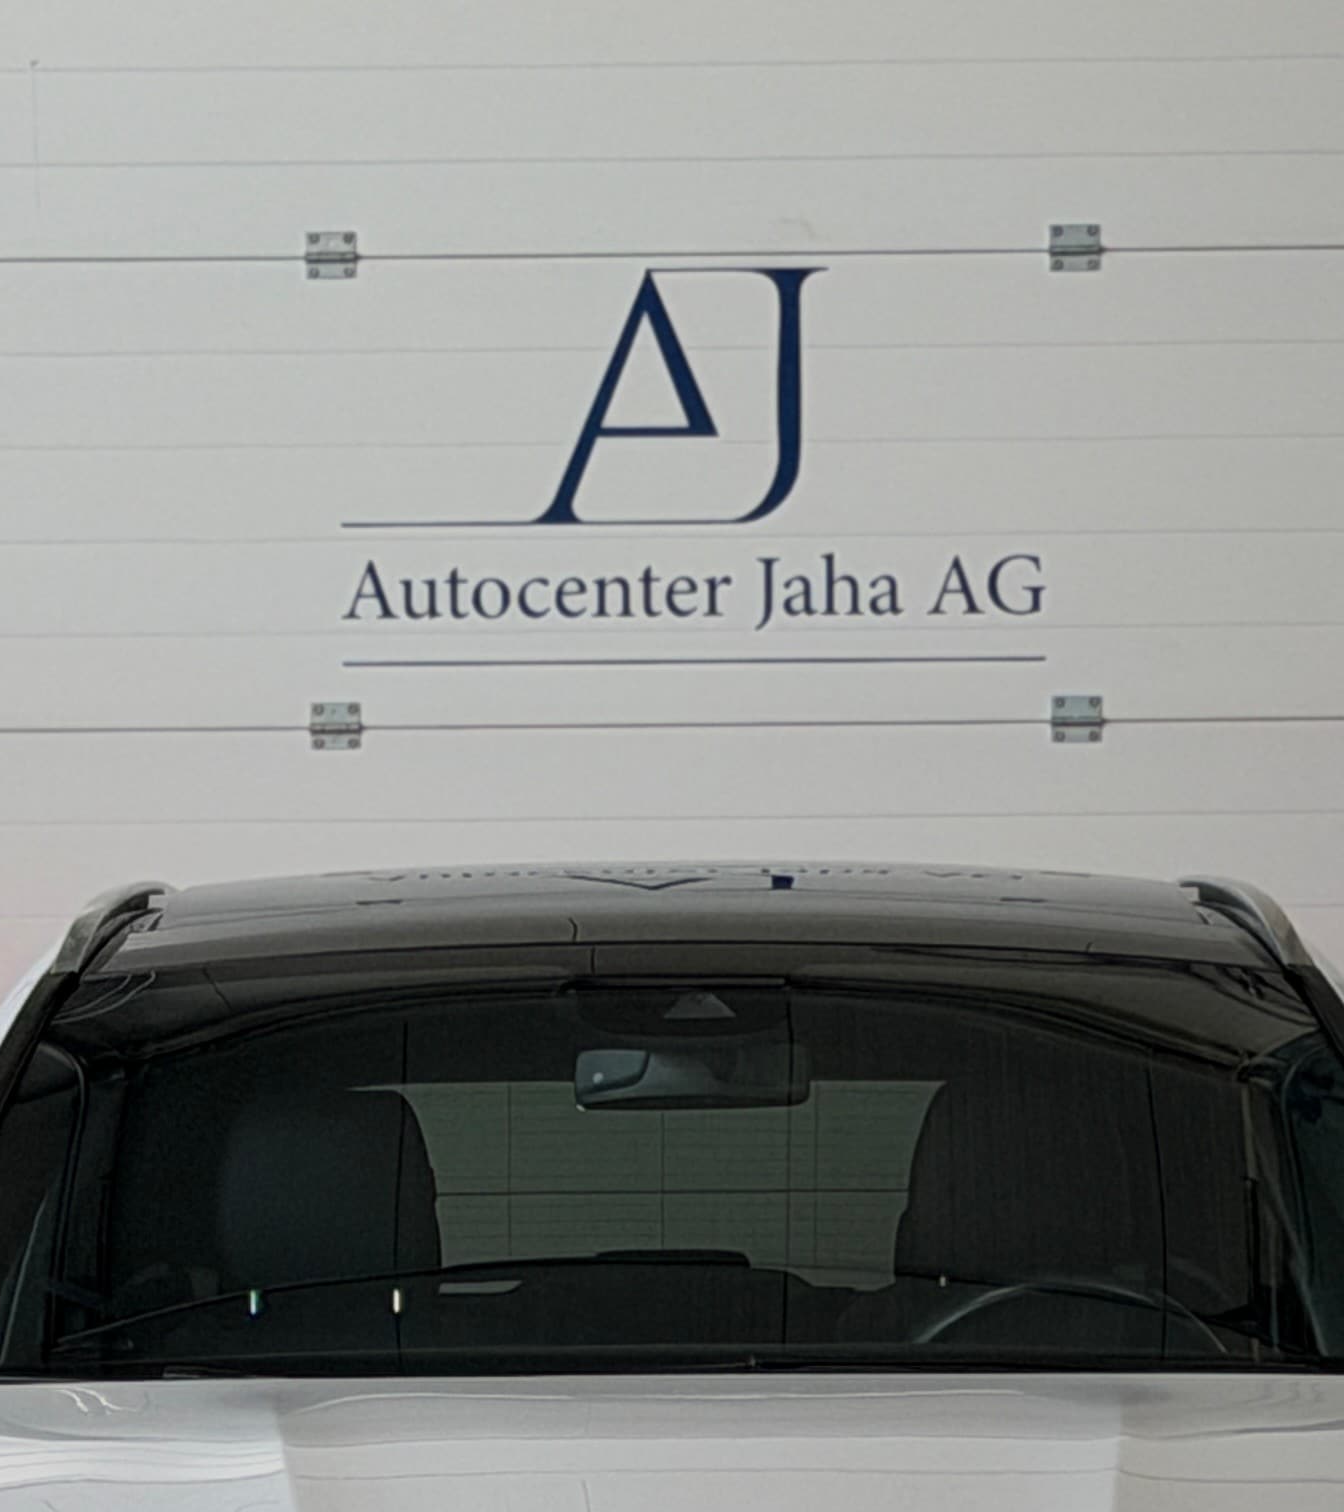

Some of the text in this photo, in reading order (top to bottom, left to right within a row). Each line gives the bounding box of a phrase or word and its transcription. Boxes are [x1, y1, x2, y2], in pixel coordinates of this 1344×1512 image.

[532, 266, 829, 526] AJ
[341, 553, 1048, 630] Autocenter Jaha AG
